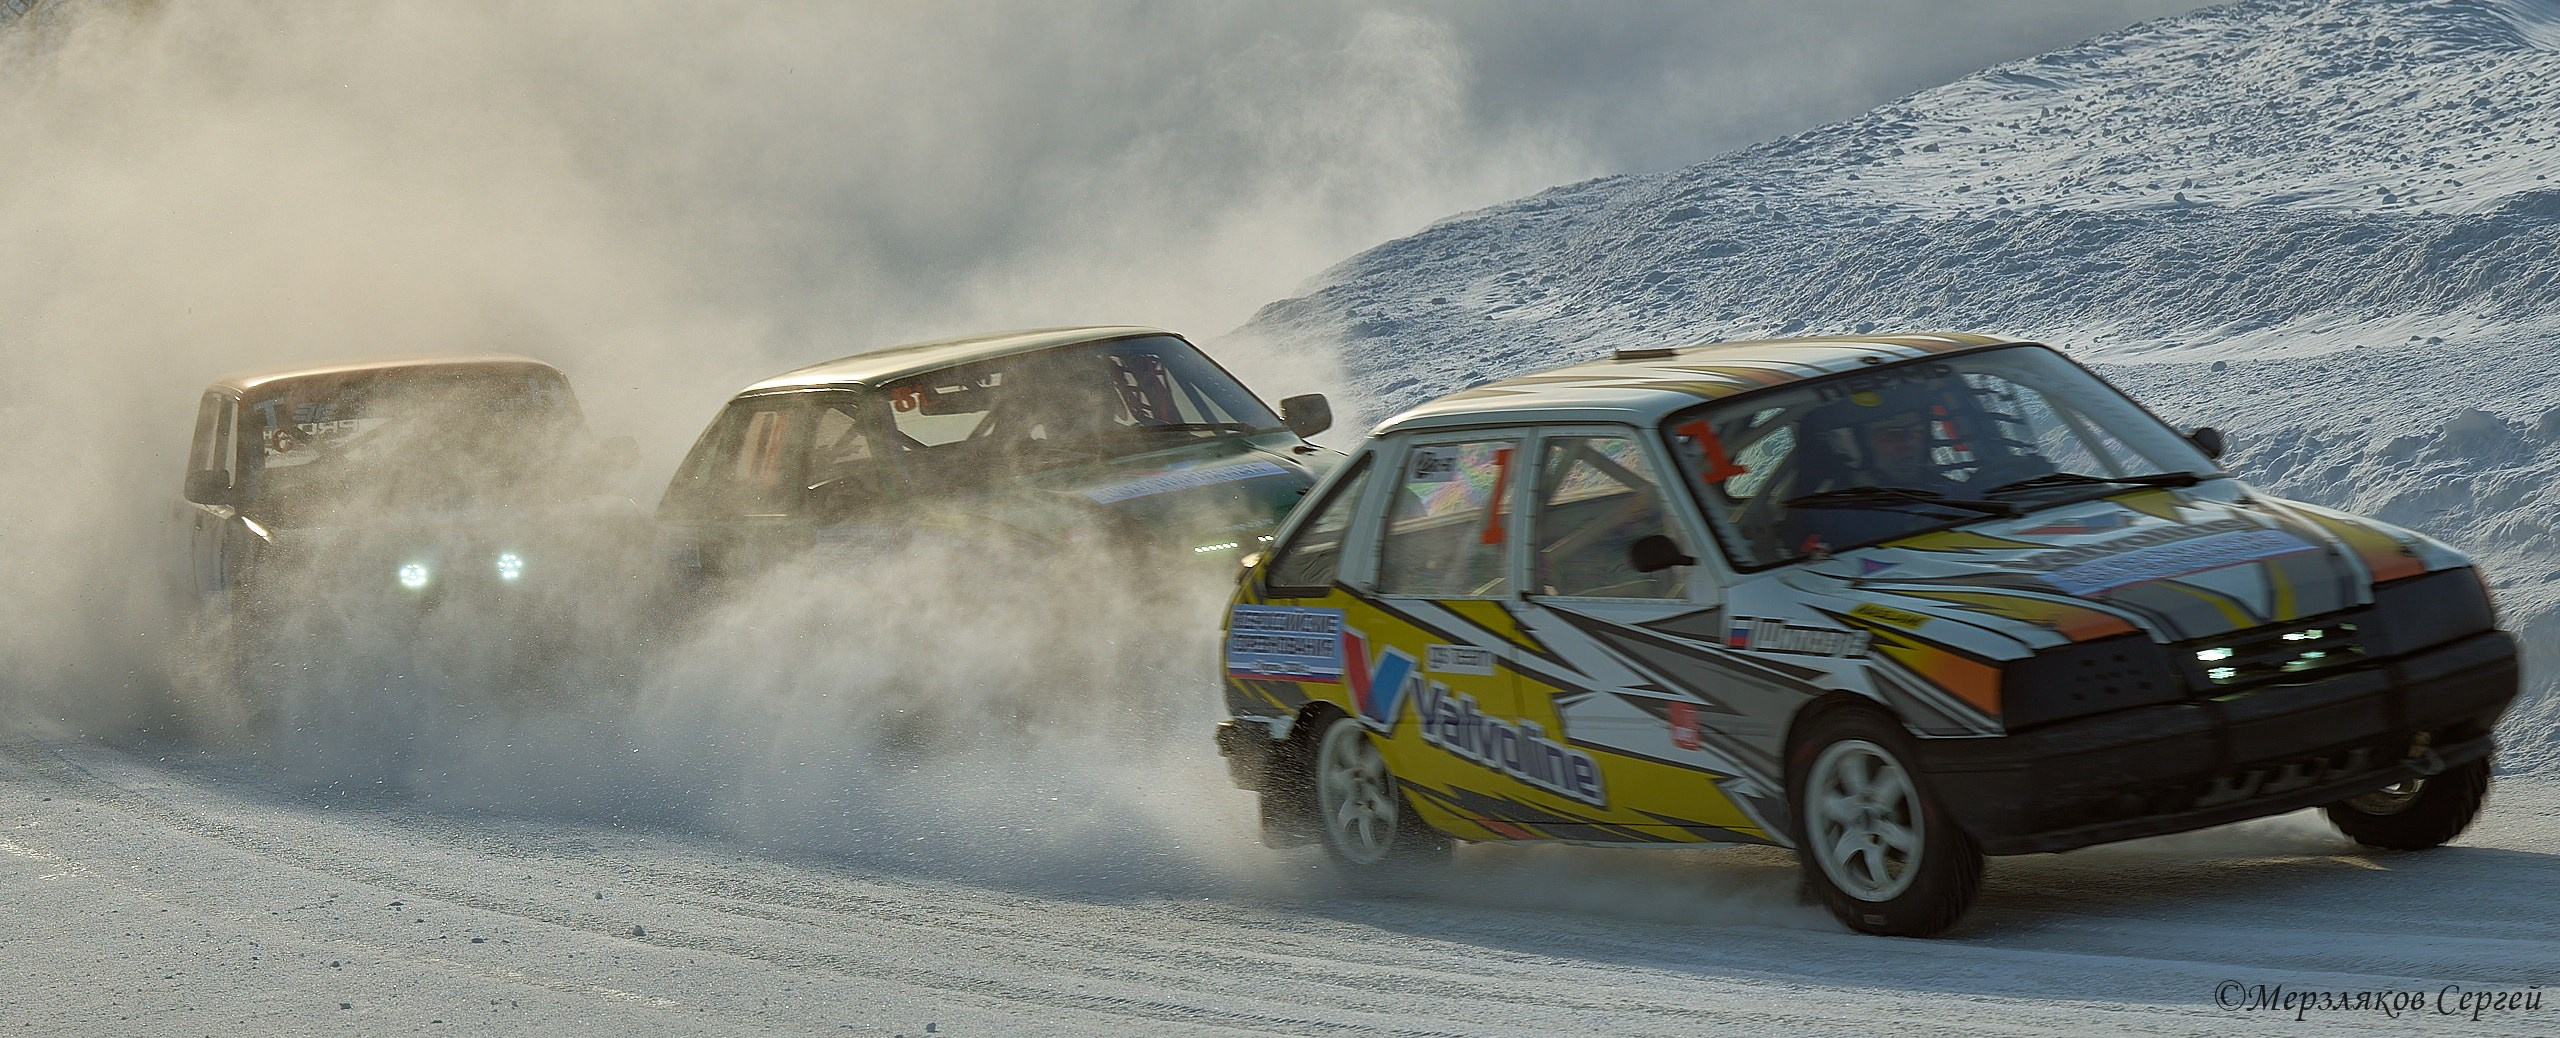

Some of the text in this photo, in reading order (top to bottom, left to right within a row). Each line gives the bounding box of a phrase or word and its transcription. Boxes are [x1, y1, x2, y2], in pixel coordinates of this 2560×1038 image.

[1480, 448, 1514, 545] 1
[1673, 419, 1752, 484] 1
[1411, 672, 1607, 807] Valvoline
